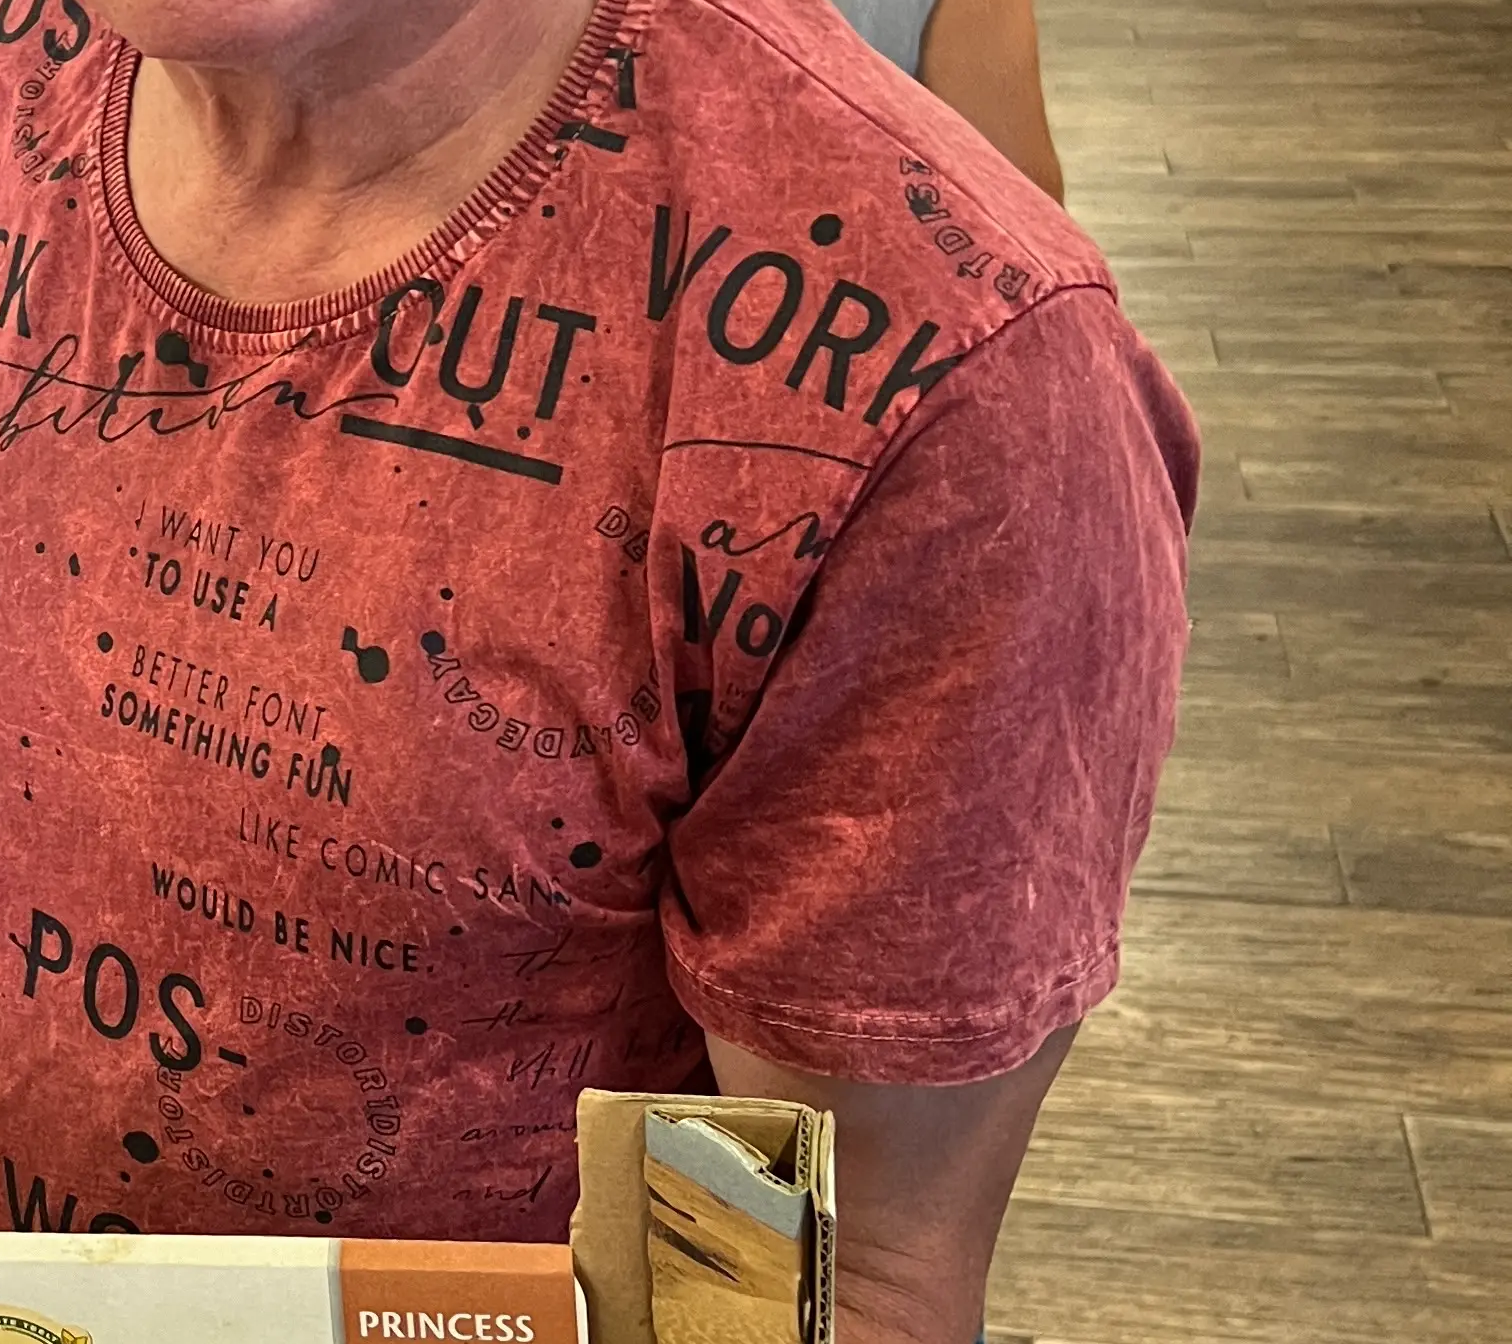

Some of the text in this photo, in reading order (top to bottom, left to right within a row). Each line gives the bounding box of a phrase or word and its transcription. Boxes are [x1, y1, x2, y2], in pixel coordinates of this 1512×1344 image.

[161, 506, 240, 562] WANT
[259, 535, 320, 583] YOU
[144, 551, 278, 632] TO USE A
[132, 645, 326, 741] BETTER FONT
[100, 683, 352, 807] SOMETHING FUN
[239, 807, 300, 859] LIKE
[320, 837, 445, 896] COMIC
[151, 862, 435, 974] WOULD BE NICE.
[359, 1311, 535, 1344] PRINCESS
